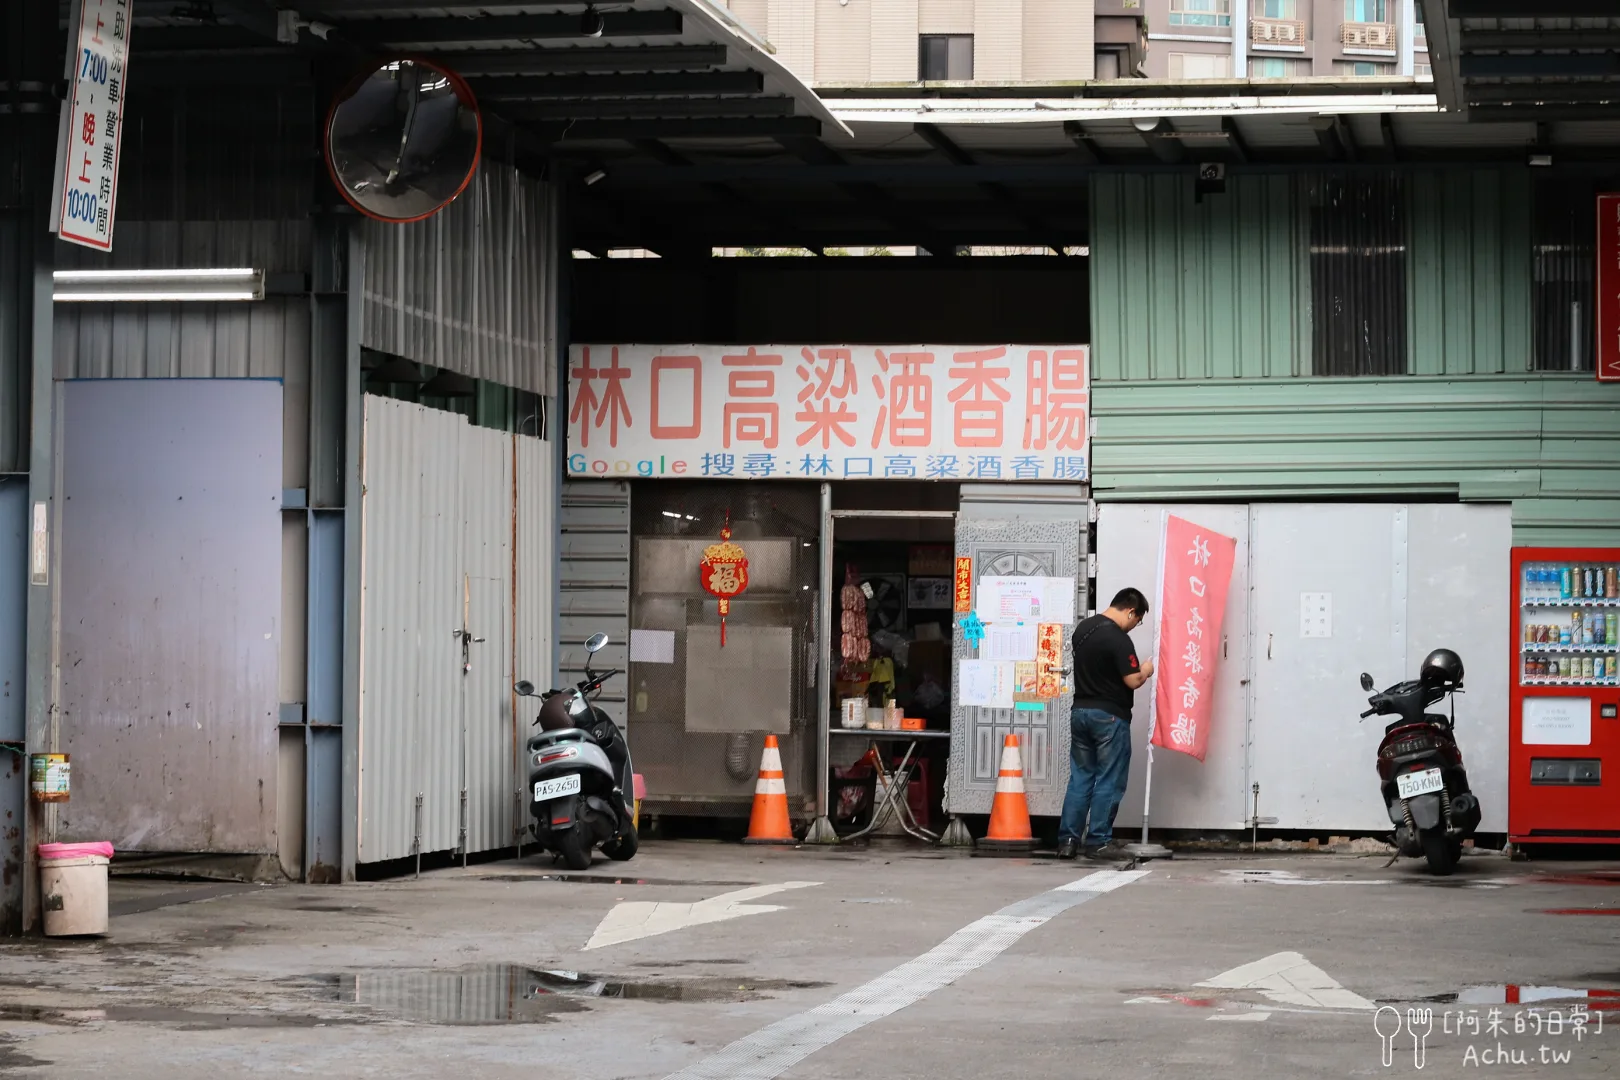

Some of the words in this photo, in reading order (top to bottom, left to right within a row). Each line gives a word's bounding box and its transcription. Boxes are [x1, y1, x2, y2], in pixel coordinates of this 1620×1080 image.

[82, 48, 107, 85] 7:00
[79, 112, 96, 183] 晚上
[68, 188, 97, 224] 10:00
[570, 345, 1089, 451] 林口高粱酒香腸
[568, 453, 687, 477] Google
[708, 562, 740, 594] 福
[957, 558, 970, 599] 開市大吉
